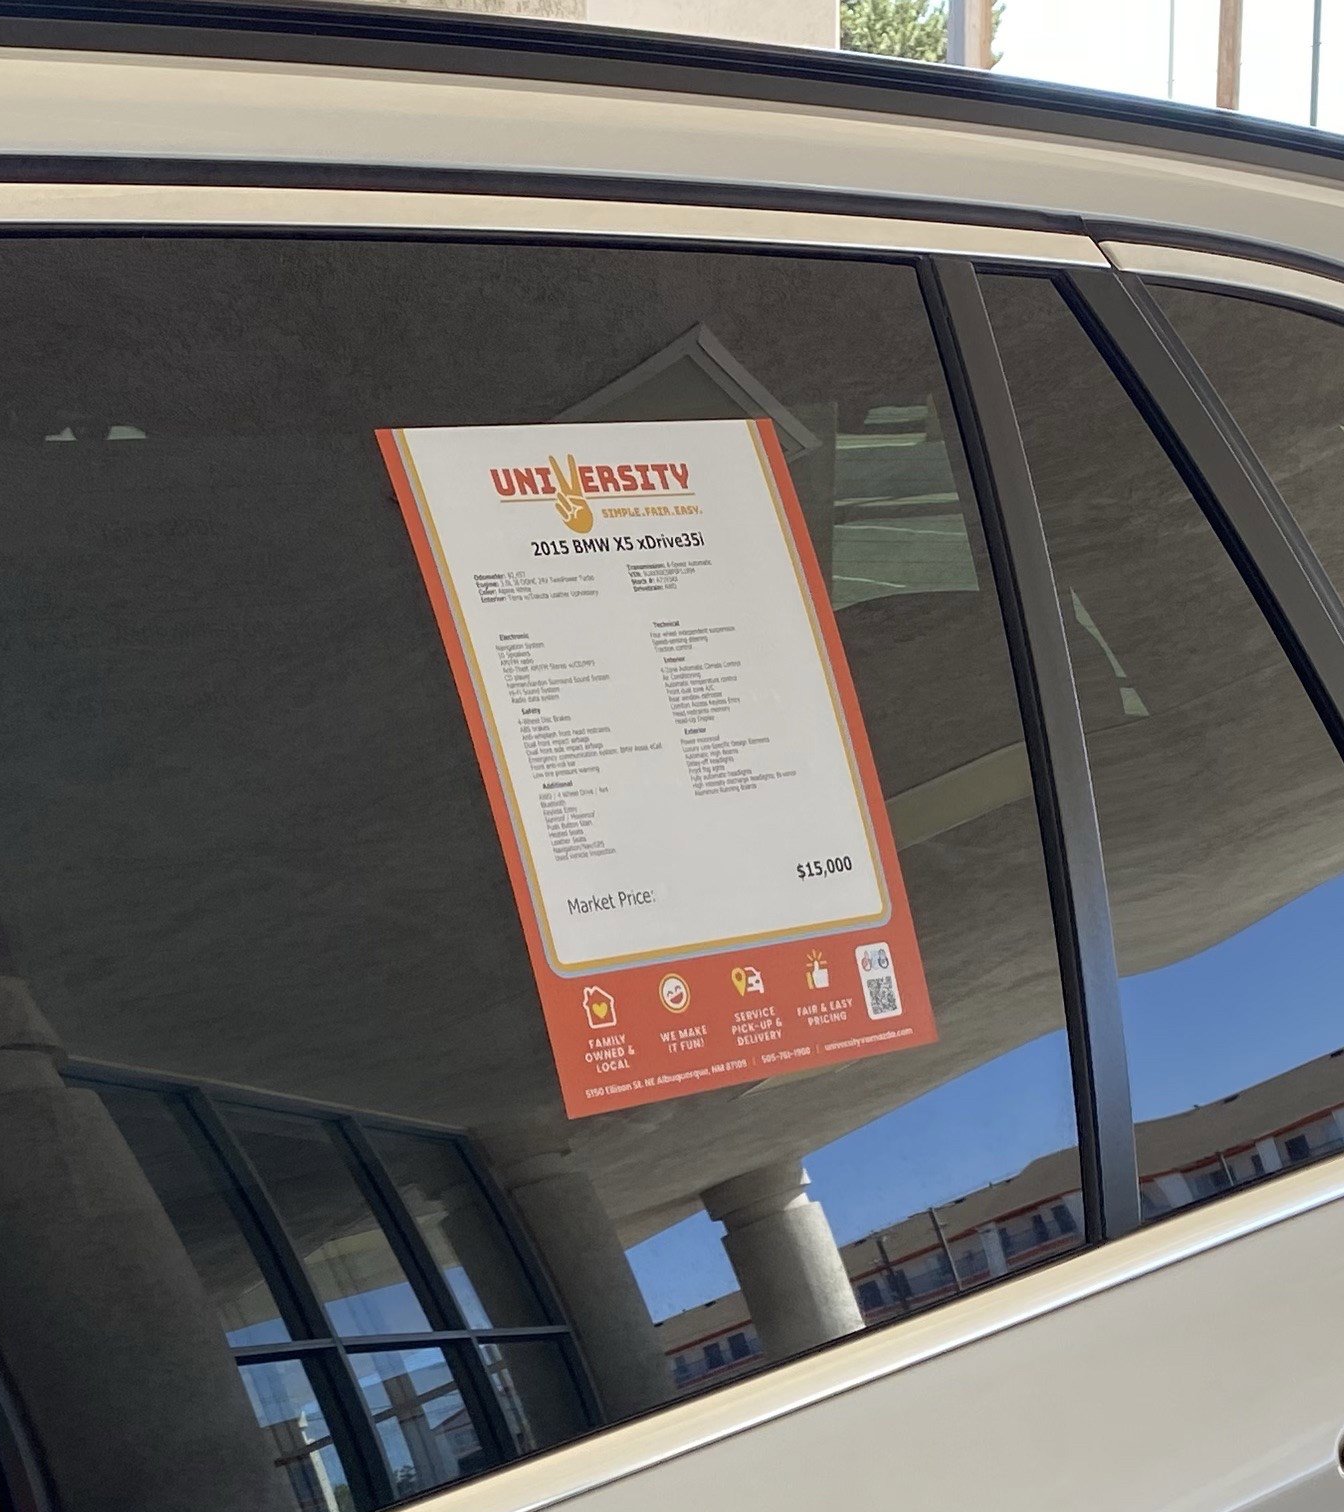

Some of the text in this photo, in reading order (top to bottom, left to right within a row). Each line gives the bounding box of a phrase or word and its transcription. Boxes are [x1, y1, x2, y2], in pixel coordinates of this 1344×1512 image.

[490, 454, 689, 496] UNIVERSITY
[601, 505, 702, 518] SIMPLE.FAIR.EASY.
[530, 531, 704, 556] 2015 BMW X5 xDrive35i
[796, 855, 852, 879] $15,000
[566, 889, 655, 914] Market Price:
[733, 1005, 775, 1022] SERVICE
[796, 997, 852, 1016] FAIR & EASY
[731, 1016, 782, 1034] PICK-UP &
[807, 1010, 847, 1026] PRICING
[588, 1034, 625, 1049] FAMILY
[659, 1024, 707, 1042] WE MAKE
[736, 1029, 781, 1046] DELIVERY
[584, 1044, 635, 1062] OWNED &
[667, 1037, 704, 1053] IT FUN!
[595, 1058, 630, 1073] LOCAL
